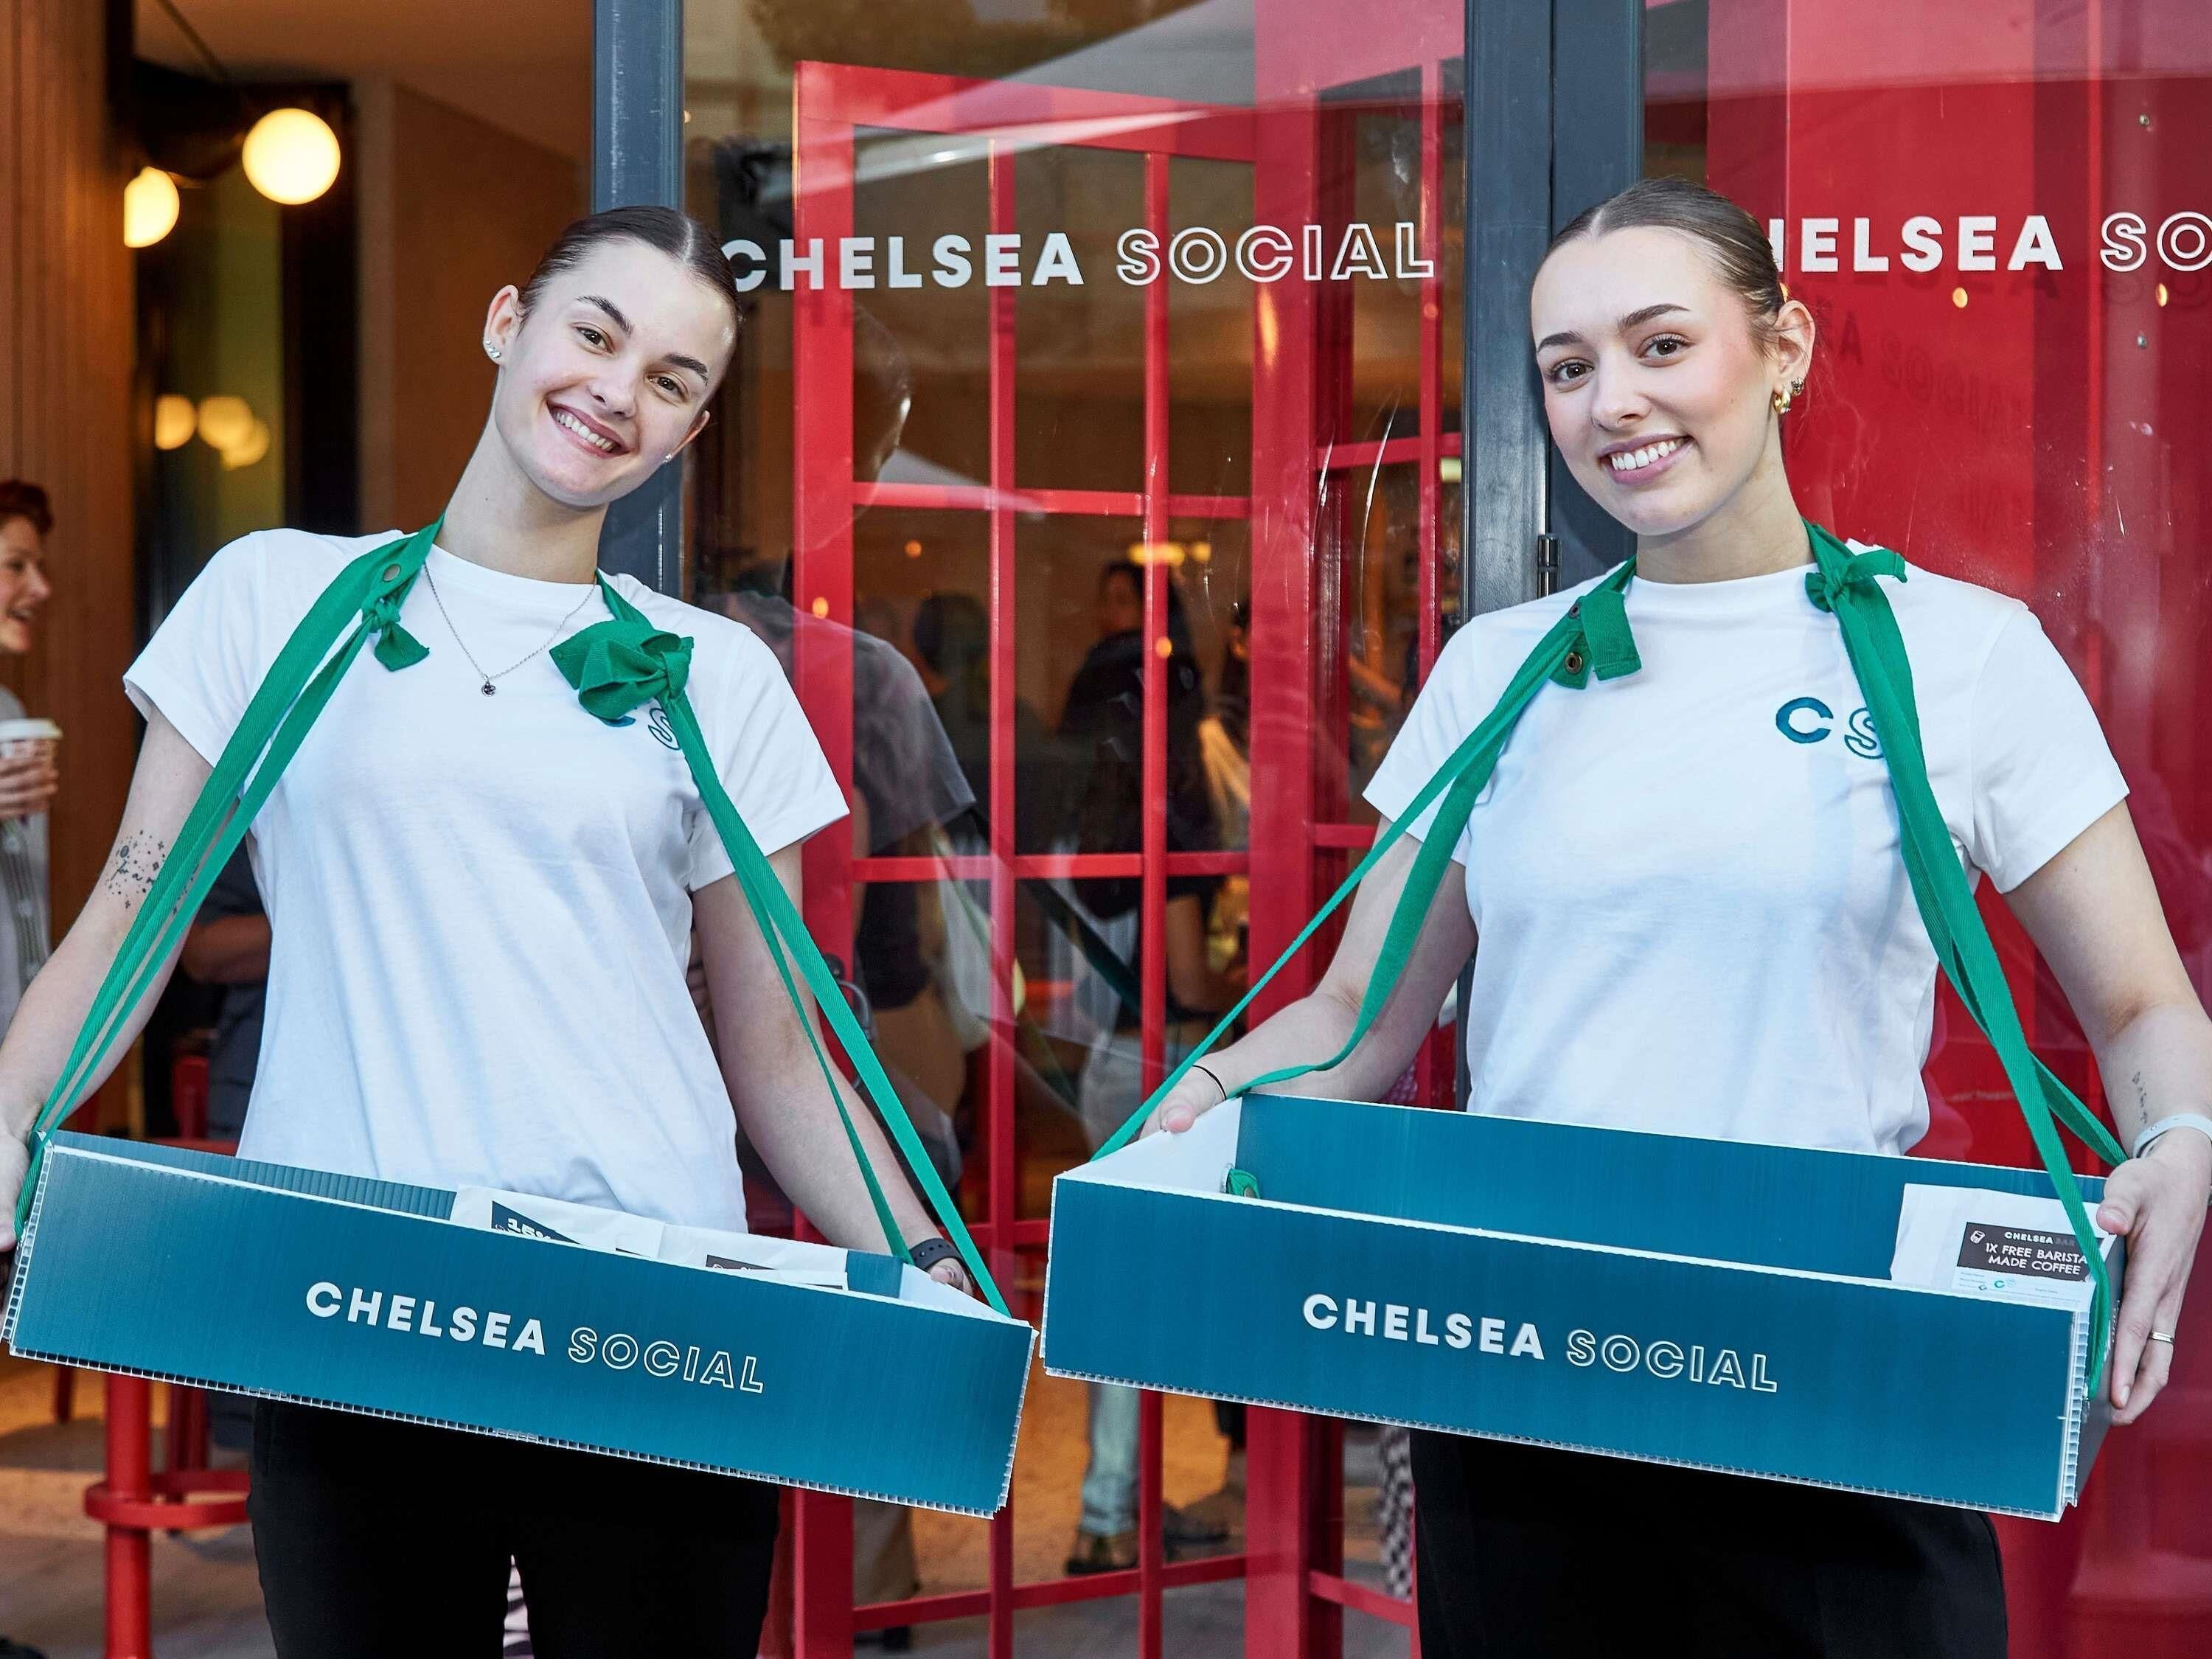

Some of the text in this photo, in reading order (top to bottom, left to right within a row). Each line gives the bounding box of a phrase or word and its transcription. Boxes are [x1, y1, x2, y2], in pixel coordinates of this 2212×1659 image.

[720, 221, 1434, 293] CHELSEA SOCIAL
[1985, 1242, 2088, 1265] 1X FREE BARISTA
[2004, 1231, 2053, 1245] CHELSEA
[1988, 1255, 2081, 1275] MADE COFFEE
[306, 1281, 765, 1394] CHELSEA SOCIAL
[1303, 1293, 1778, 1394] CHELSEA SOCIAL
